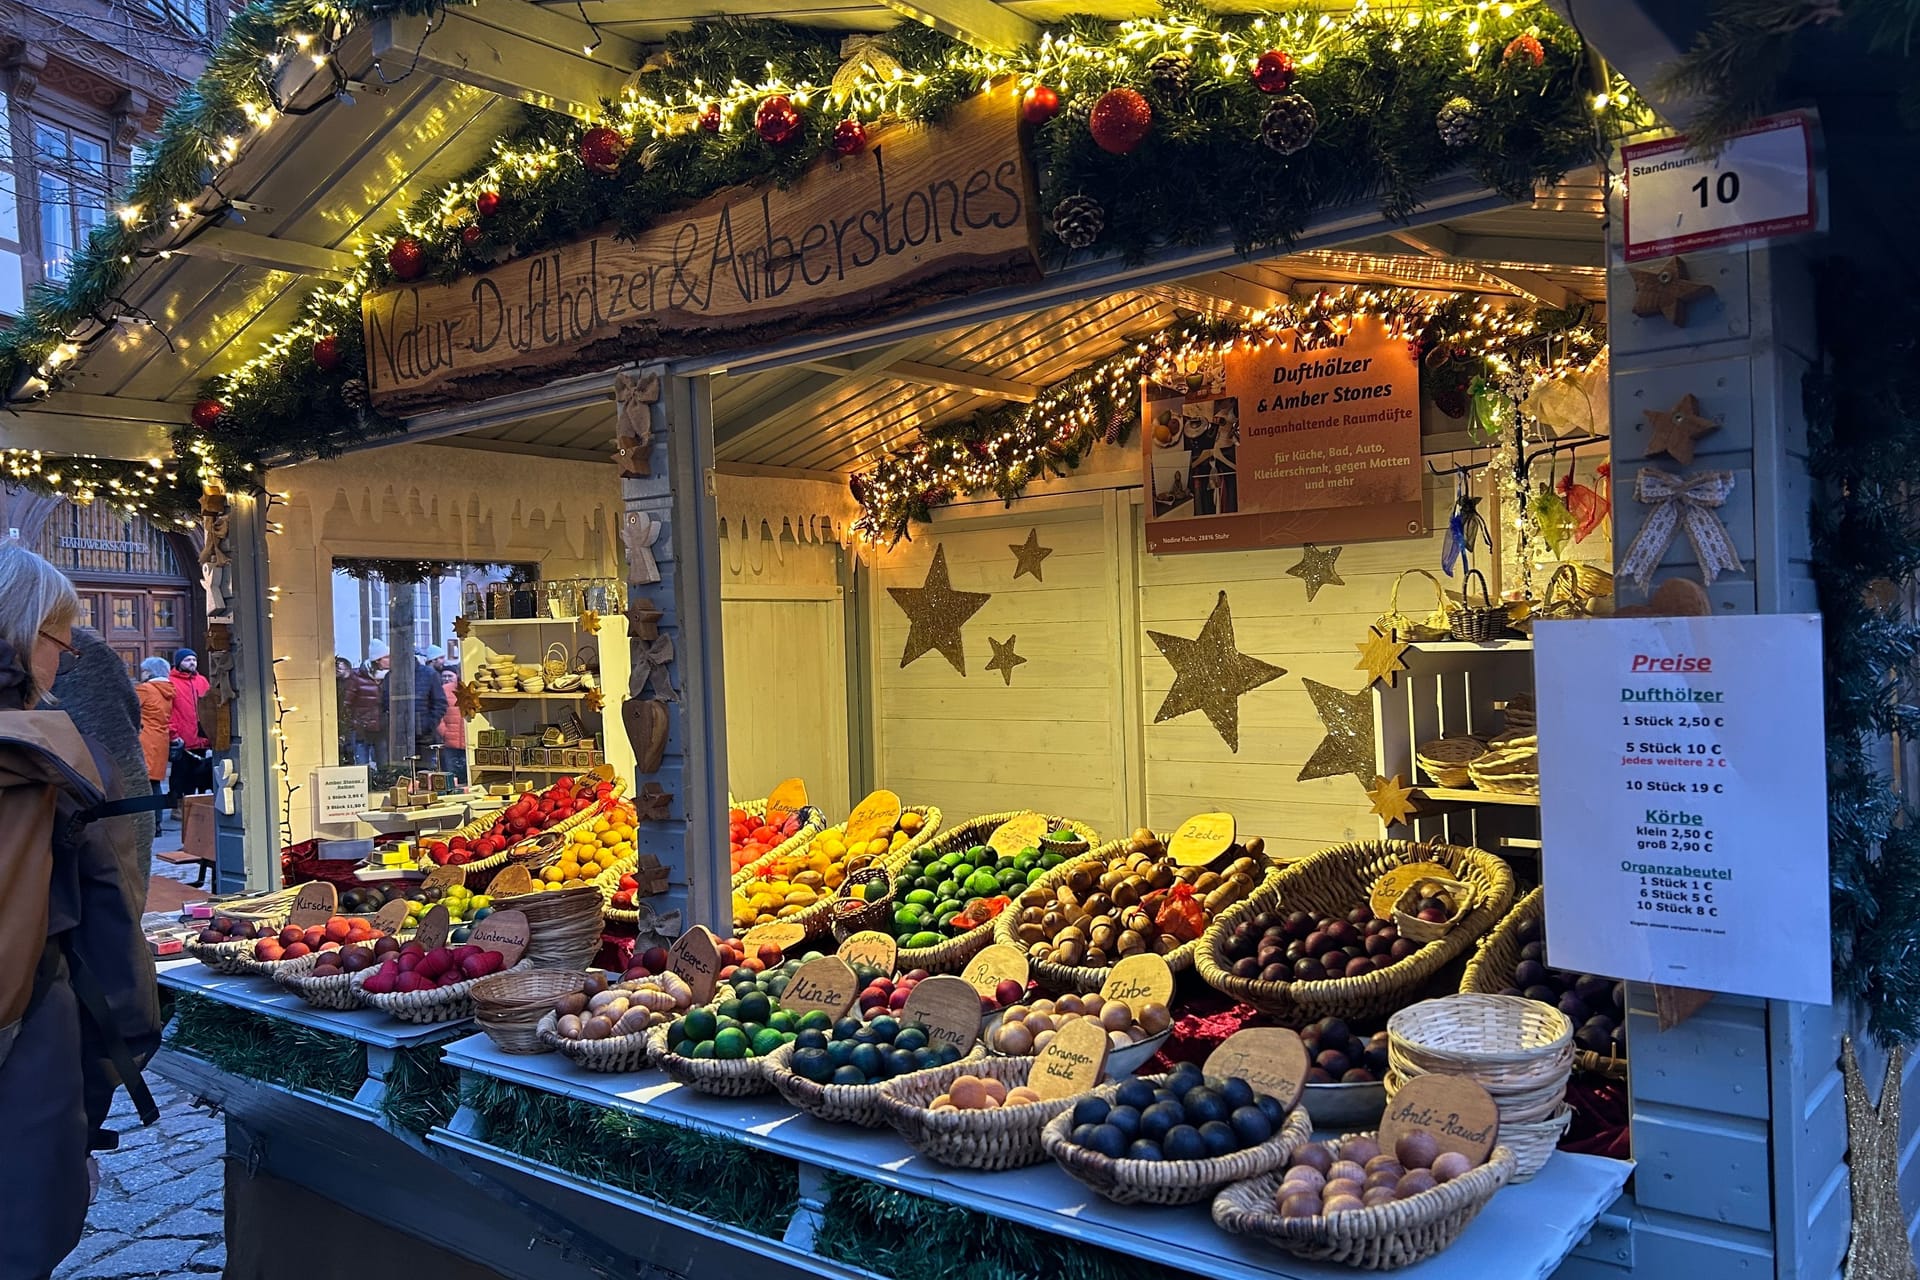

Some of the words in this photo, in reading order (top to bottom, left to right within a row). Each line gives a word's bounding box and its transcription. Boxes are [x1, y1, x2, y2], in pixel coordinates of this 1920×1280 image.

[1692, 171, 1740, 209] 10
[669, 222, 706, 310] &
[701, 144, 1021, 310] Amberstones
[1293, 333, 1348, 353] Natur
[1273, 356, 1373, 385] Dufthölzer
[1257, 398, 1268, 413] &
[1272, 391, 1329, 411] Amber
[1333, 383, 1392, 404] Stones
[1249, 416, 1340, 438] Langanhaltende
[1343, 407, 1413, 426] Raumdüfte
[1274, 451, 1290, 465] für
[1292, 448, 1326, 461] Küche,
[1329, 445, 1352, 458] Bad,
[1355, 443, 1386, 455] Auto,
[1254, 463, 1332, 480] Kleiderschrank,
[1334, 462, 1367, 476] gegen
[1370, 456, 1411, 469] Motten
[1305, 477, 1324, 490] und
[1327, 476, 1355, 488] mehr
[1631, 654, 1712, 673] Preise
[1621, 688, 1724, 703] Dufthölzer
[1623, 717, 1630, 726] 1
[1634, 716, 1673, 726] Stück
[1679, 717, 1710, 728] 2,50
[1715, 717, 1724, 727] €
[1626, 743, 1635, 752] 5
[1639, 742, 1682, 753] Stück
[1688, 744, 1706, 754] 10
[1712, 745, 1722, 755] €
[1622, 756, 1653, 766] jedes
[1657, 757, 1703, 767] weitere
[1707, 759, 1714, 767] 2
[1718, 759, 1727, 767] €
[1626, 781, 1643, 790] 10
[1647, 781, 1686, 792] Stück
[1692, 783, 1709, 793] 19
[1713, 784, 1723, 794] €
[1645, 809, 1703, 826] Körbe
[1184, 826, 1224, 840] Zeder
[1636, 826, 1667, 837] klein
[1672, 829, 1700, 839] 2,50
[1704, 830, 1713, 840] €
[1637, 840, 1667, 850] groß
[1671, 841, 1700, 852] 2,90
[1704, 843, 1713, 853] €
[1621, 860, 1732, 880] Organzabeutel
[1640, 876, 1647, 885] 1
[1651, 877, 1687, 889] Stück
[1692, 881, 1699, 890] 1
[1703, 881, 1713, 891] €
[296, 896, 333, 911] Kirsche
[1640, 889, 1648, 898] 6
[1652, 889, 1688, 901] Stück
[1692, 893, 1700, 902] 5
[1704, 894, 1713, 904] €
[1637, 901, 1652, 910] 10
[1656, 902, 1692, 915] Stück
[1697, 906, 1704, 915] 8
[1709, 907, 1718, 917] €
[473, 929, 525, 947] Winterwald
[674, 938, 711, 975] Meeres-
[672, 961, 695, 987] brise
[785, 975, 842, 1007] Minze
[1108, 978, 1153, 1001] Zirbe
[1047, 1044, 1093, 1067] Orangen-
[1047, 1063, 1074, 1080] blüte
[1391, 1102, 1494, 1144] Anti-Rauch
